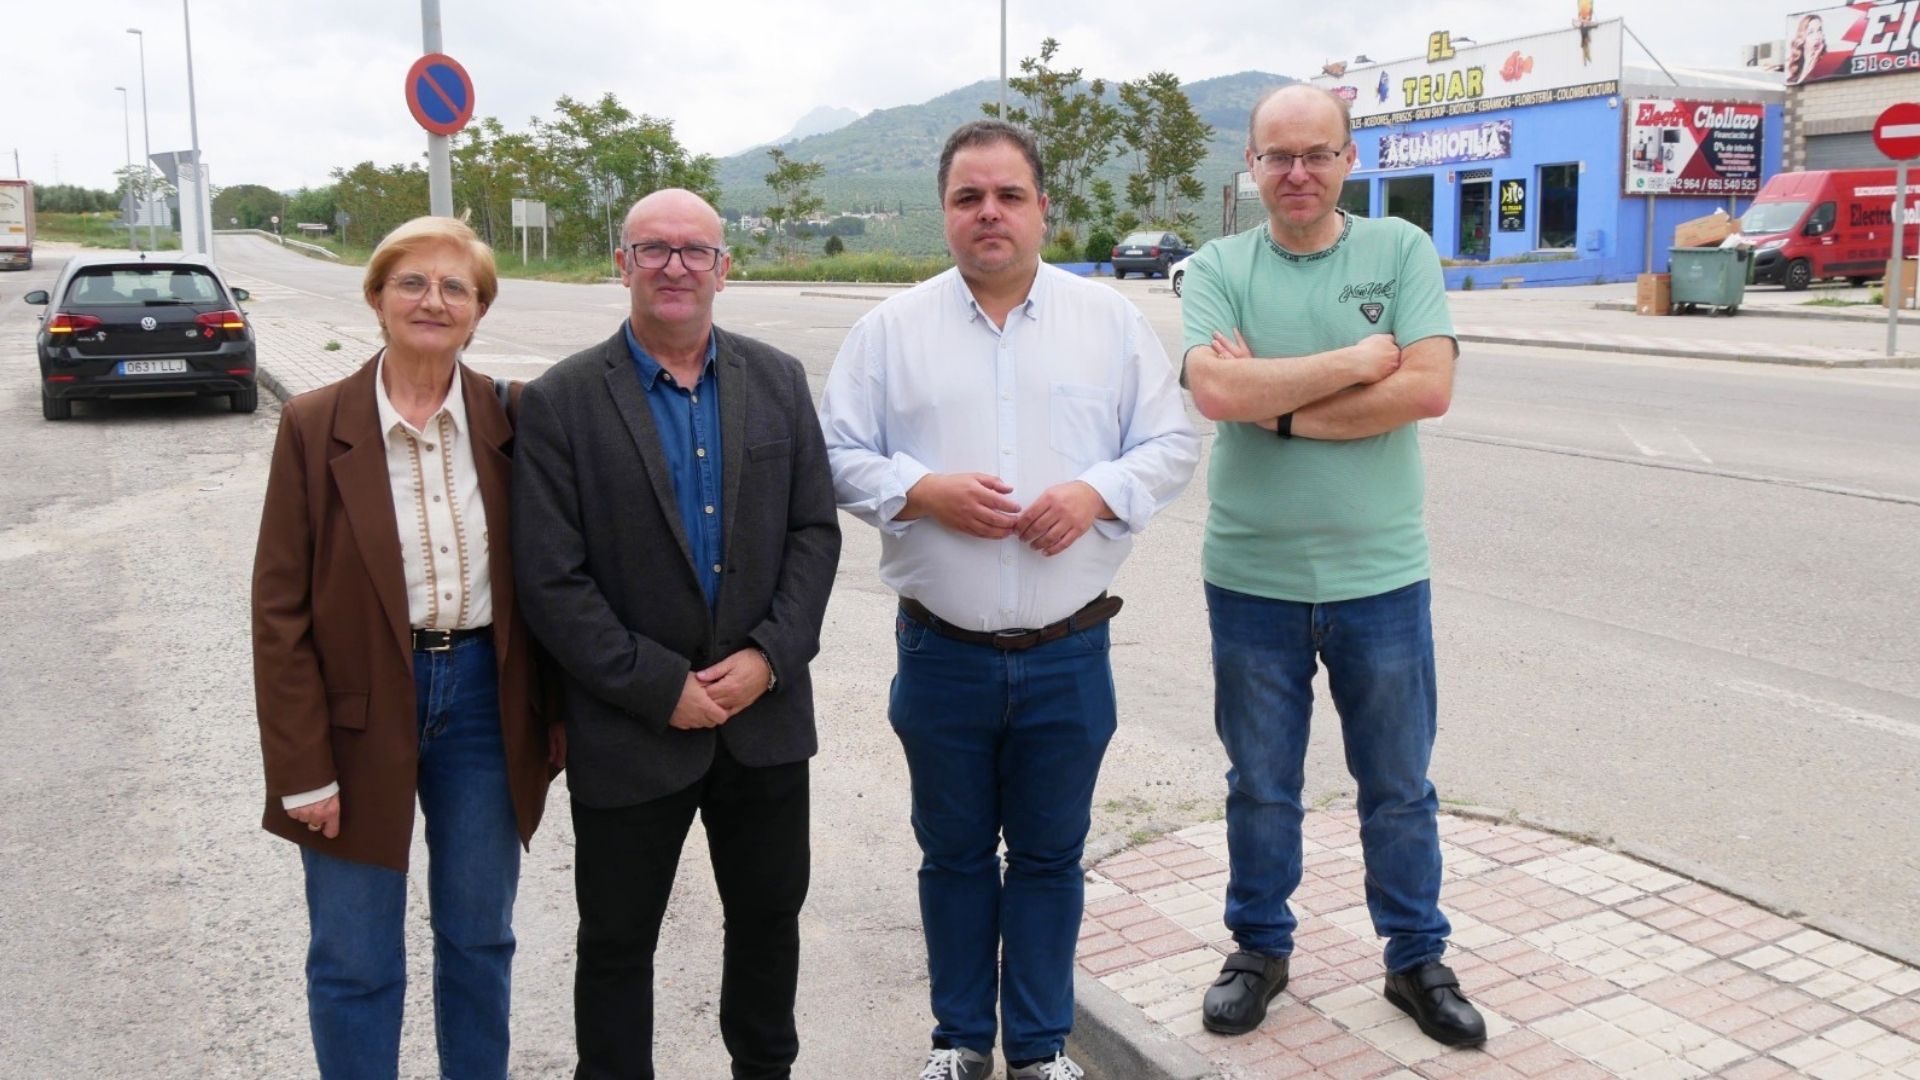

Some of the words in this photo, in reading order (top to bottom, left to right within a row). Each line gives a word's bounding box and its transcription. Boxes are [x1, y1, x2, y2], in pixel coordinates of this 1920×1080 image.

[1853, 1, 1920, 56] El
[1427, 31, 1455, 63] EL
[1403, 67, 1484, 106] TEJAR
[1693, 105, 1759, 128] Chollazo
[127, 362, 157, 372] 0631
[161, 360, 184, 372] LLJ
